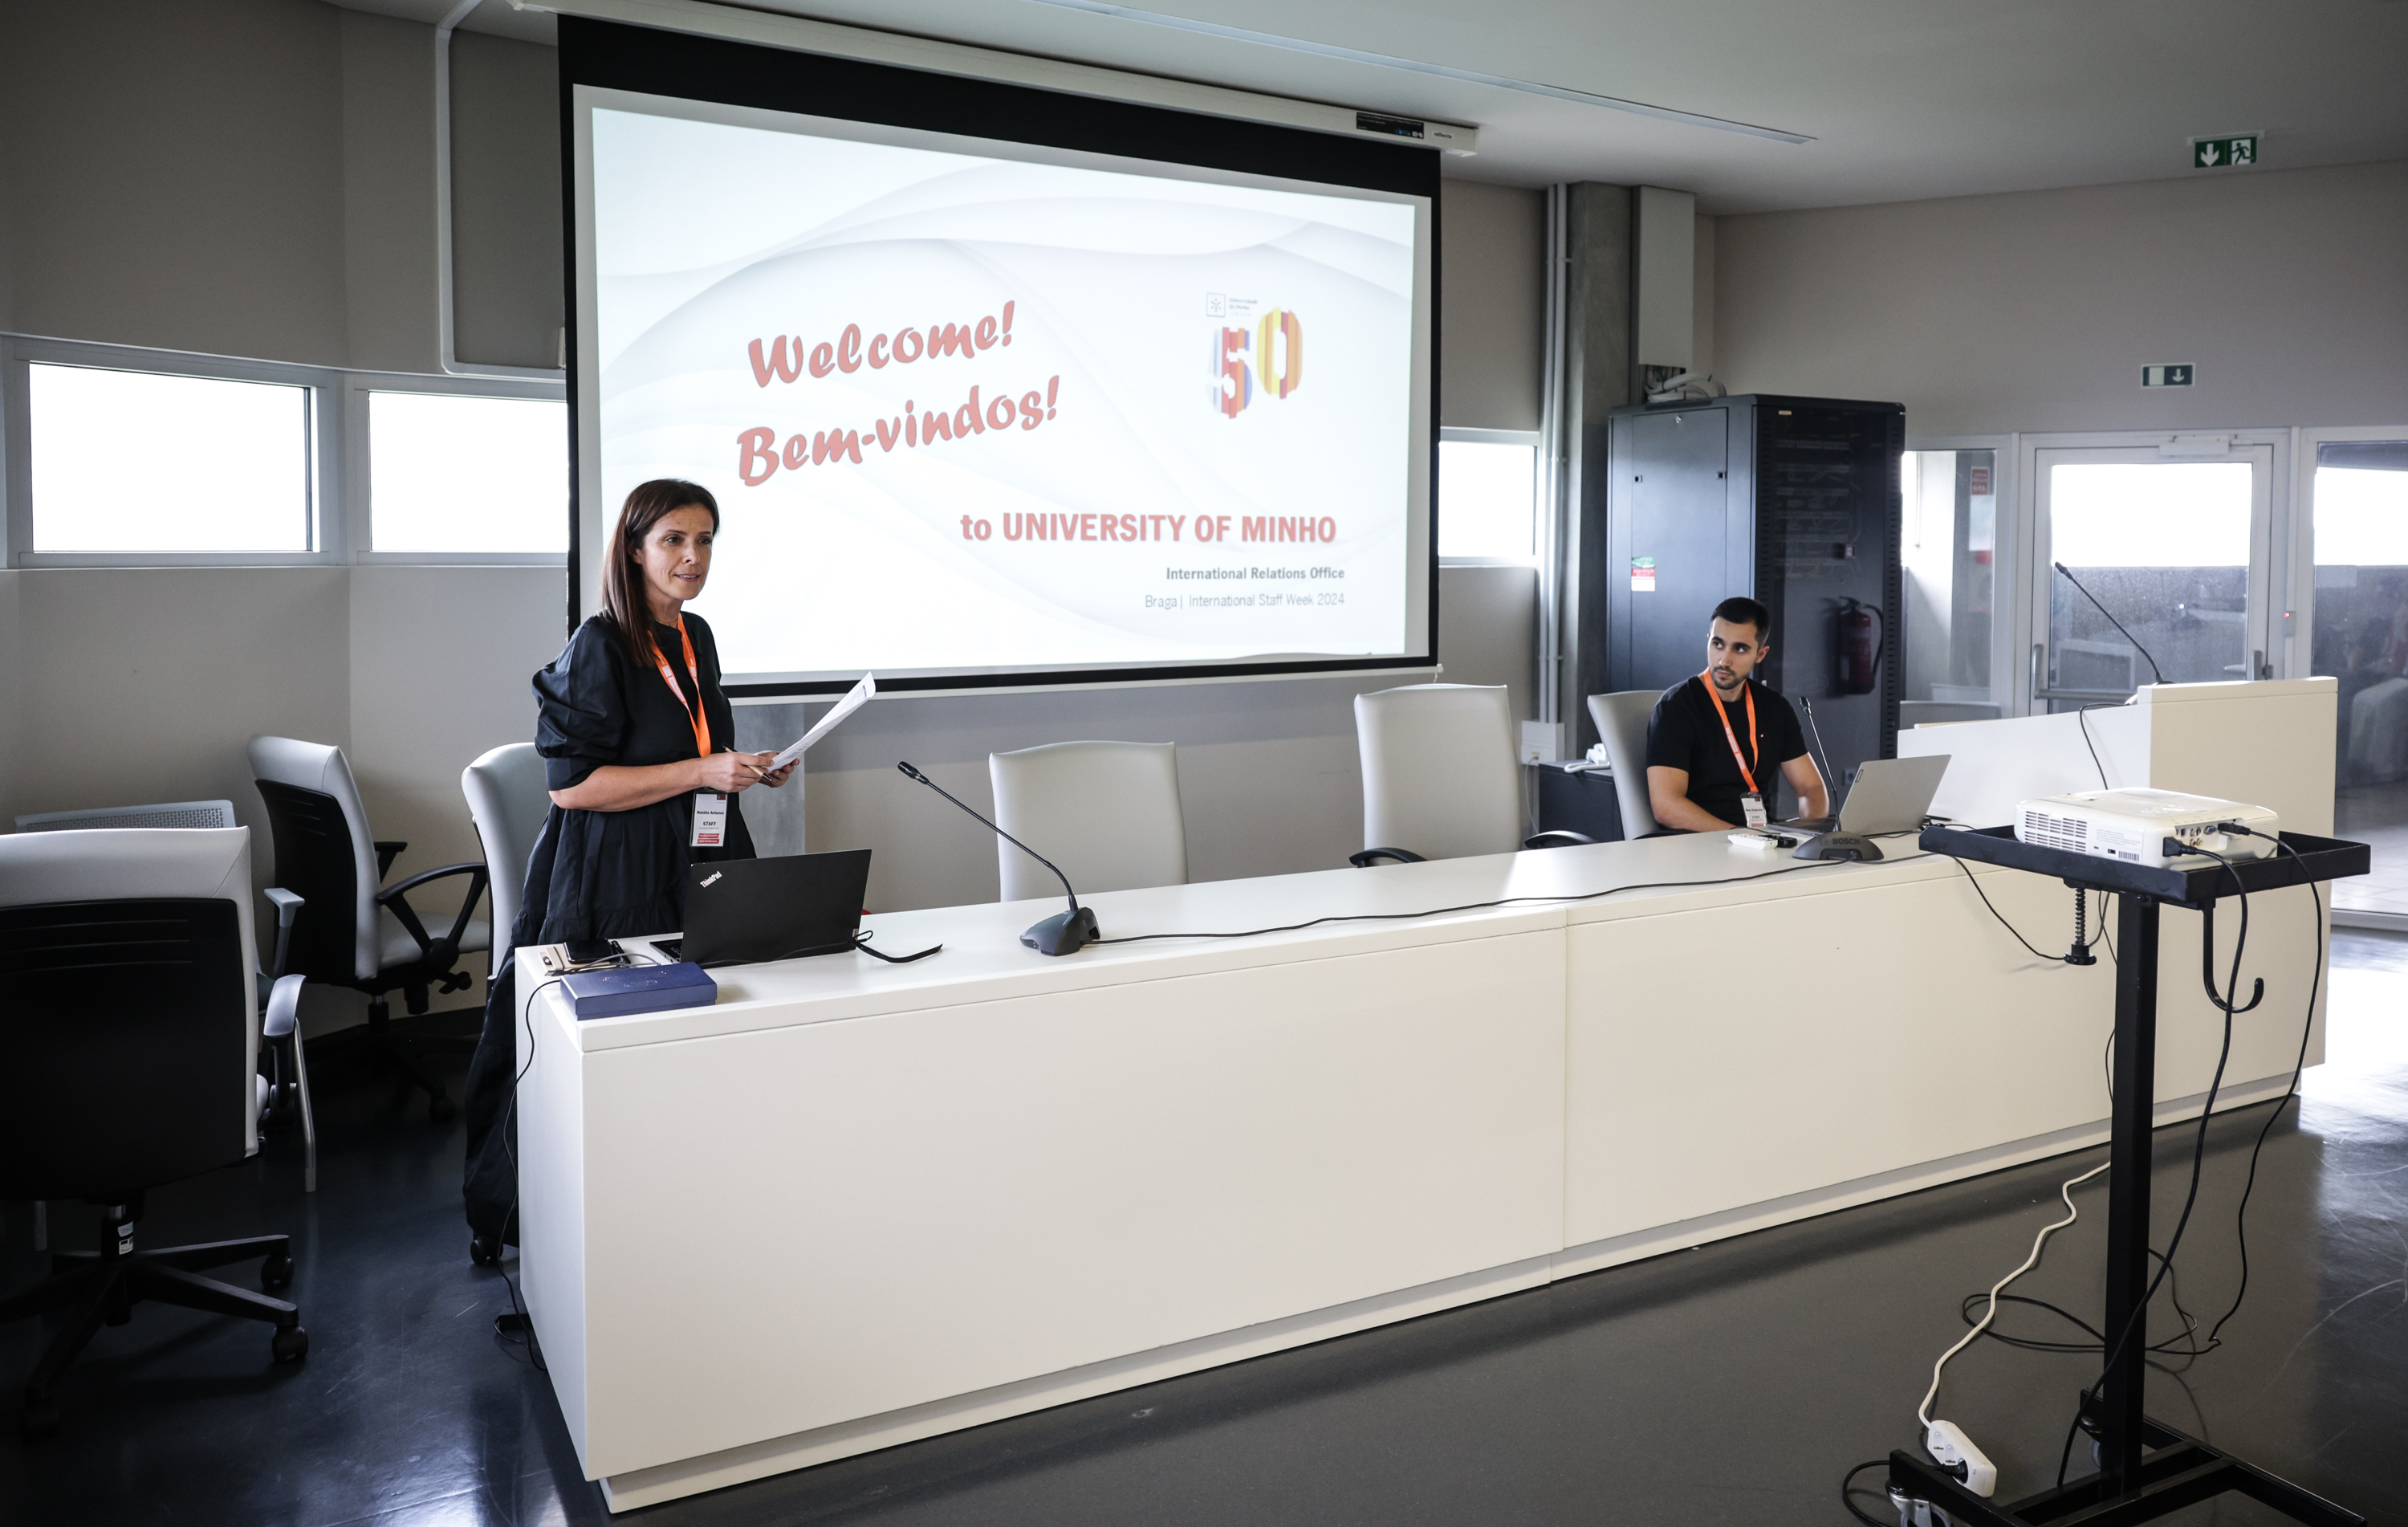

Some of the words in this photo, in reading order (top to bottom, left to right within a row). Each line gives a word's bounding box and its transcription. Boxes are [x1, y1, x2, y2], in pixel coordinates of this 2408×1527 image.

[747, 299, 1015, 389] Welcome!
[1206, 307, 1304, 420] 50
[736, 375, 1060, 487] Bem-vindos!
[960, 515, 992, 542] to
[1003, 512, 1186, 543] UNIVERSITY
[1194, 515, 1232, 543] OF
[1241, 515, 1336, 544] MINHO
[1166, 567, 1247, 580] International
[1251, 567, 1307, 580] Relations
[1309, 566, 1345, 580] Office
[1189, 594, 1255, 608] International
[1259, 592, 1283, 607] Staff
[1286, 593, 1314, 606] Week
[1316, 592, 1345, 606] 2024
[700, 870, 722, 888] ThinkPad
